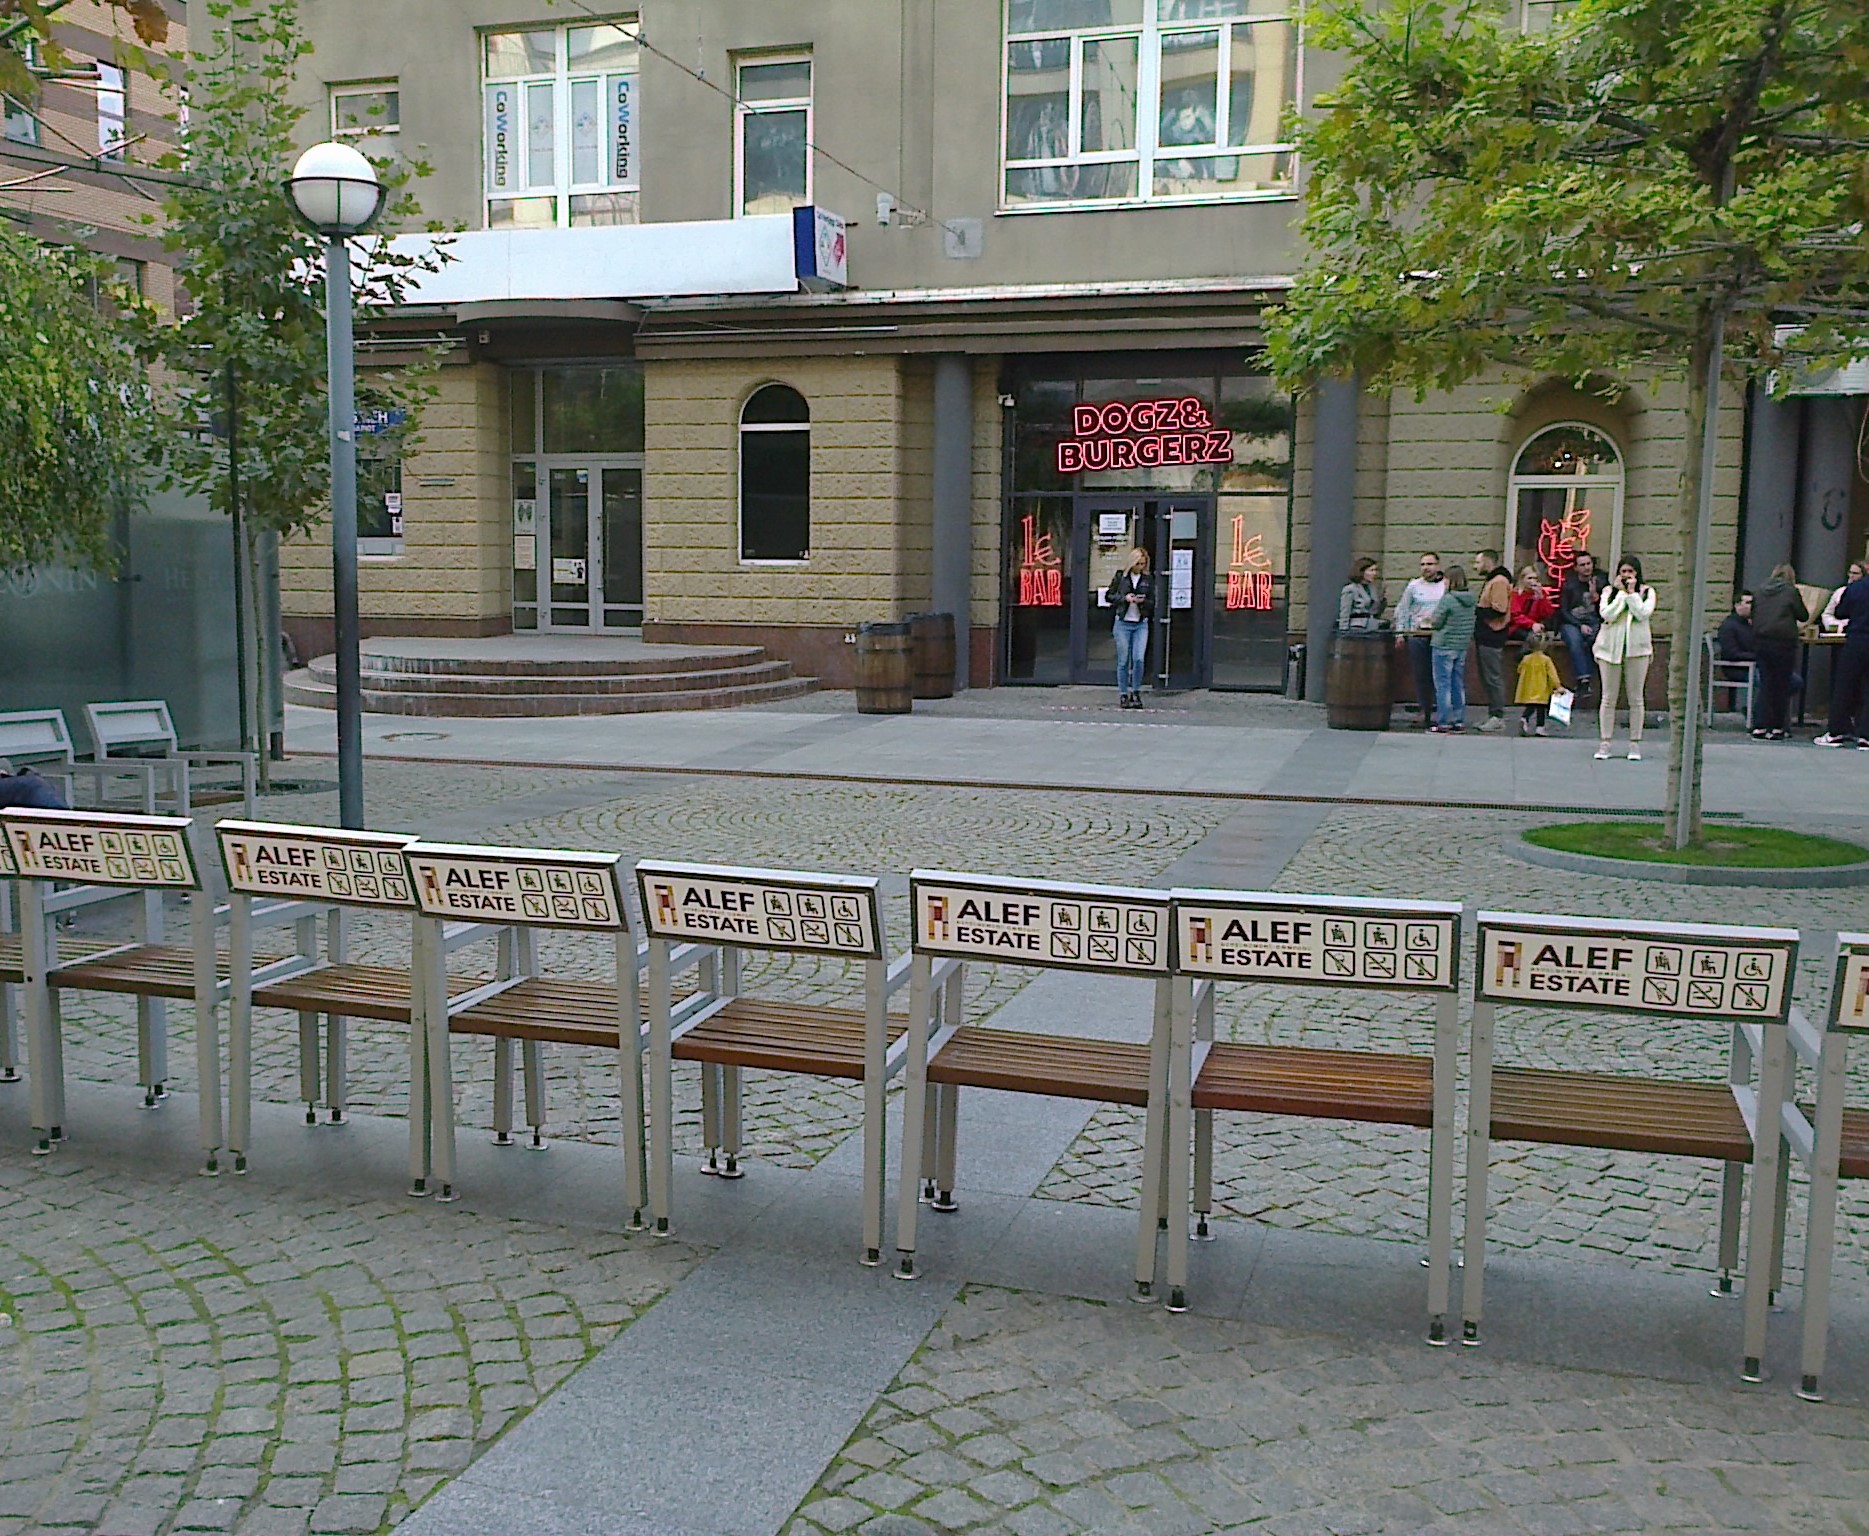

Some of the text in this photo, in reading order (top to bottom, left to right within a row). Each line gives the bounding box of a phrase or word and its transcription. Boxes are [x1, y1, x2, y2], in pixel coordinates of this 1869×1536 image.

[495, 91, 509, 187] CoWorking
[616, 81, 630, 178] CoWorking
[1074, 397, 1213, 436] DOGZ&
[1058, 430, 1233, 473] BURGERZ
[1019, 568, 1063, 606] BAR
[1226, 570, 1273, 610] BAR
[40, 831, 94, 853] ALEF
[42, 855, 102, 874] ESTATE
[255, 845, 316, 867] ALEF
[257, 870, 322, 889] ESTATE
[445, 868, 510, 890] ALEF
[448, 893, 517, 912] ESTATE
[682, 887, 755, 912] ALEF
[684, 912, 760, 935] ESTATE
[957, 899, 1040, 926] ALEF
[957, 926, 1040, 951] ESTATE
[1221, 919, 1312, 944] ALEF
[1221, 948, 1312, 969] ESTATE
[1531, 944, 1633, 971] ALEF
[1530, 973, 1631, 997] ESTATE
